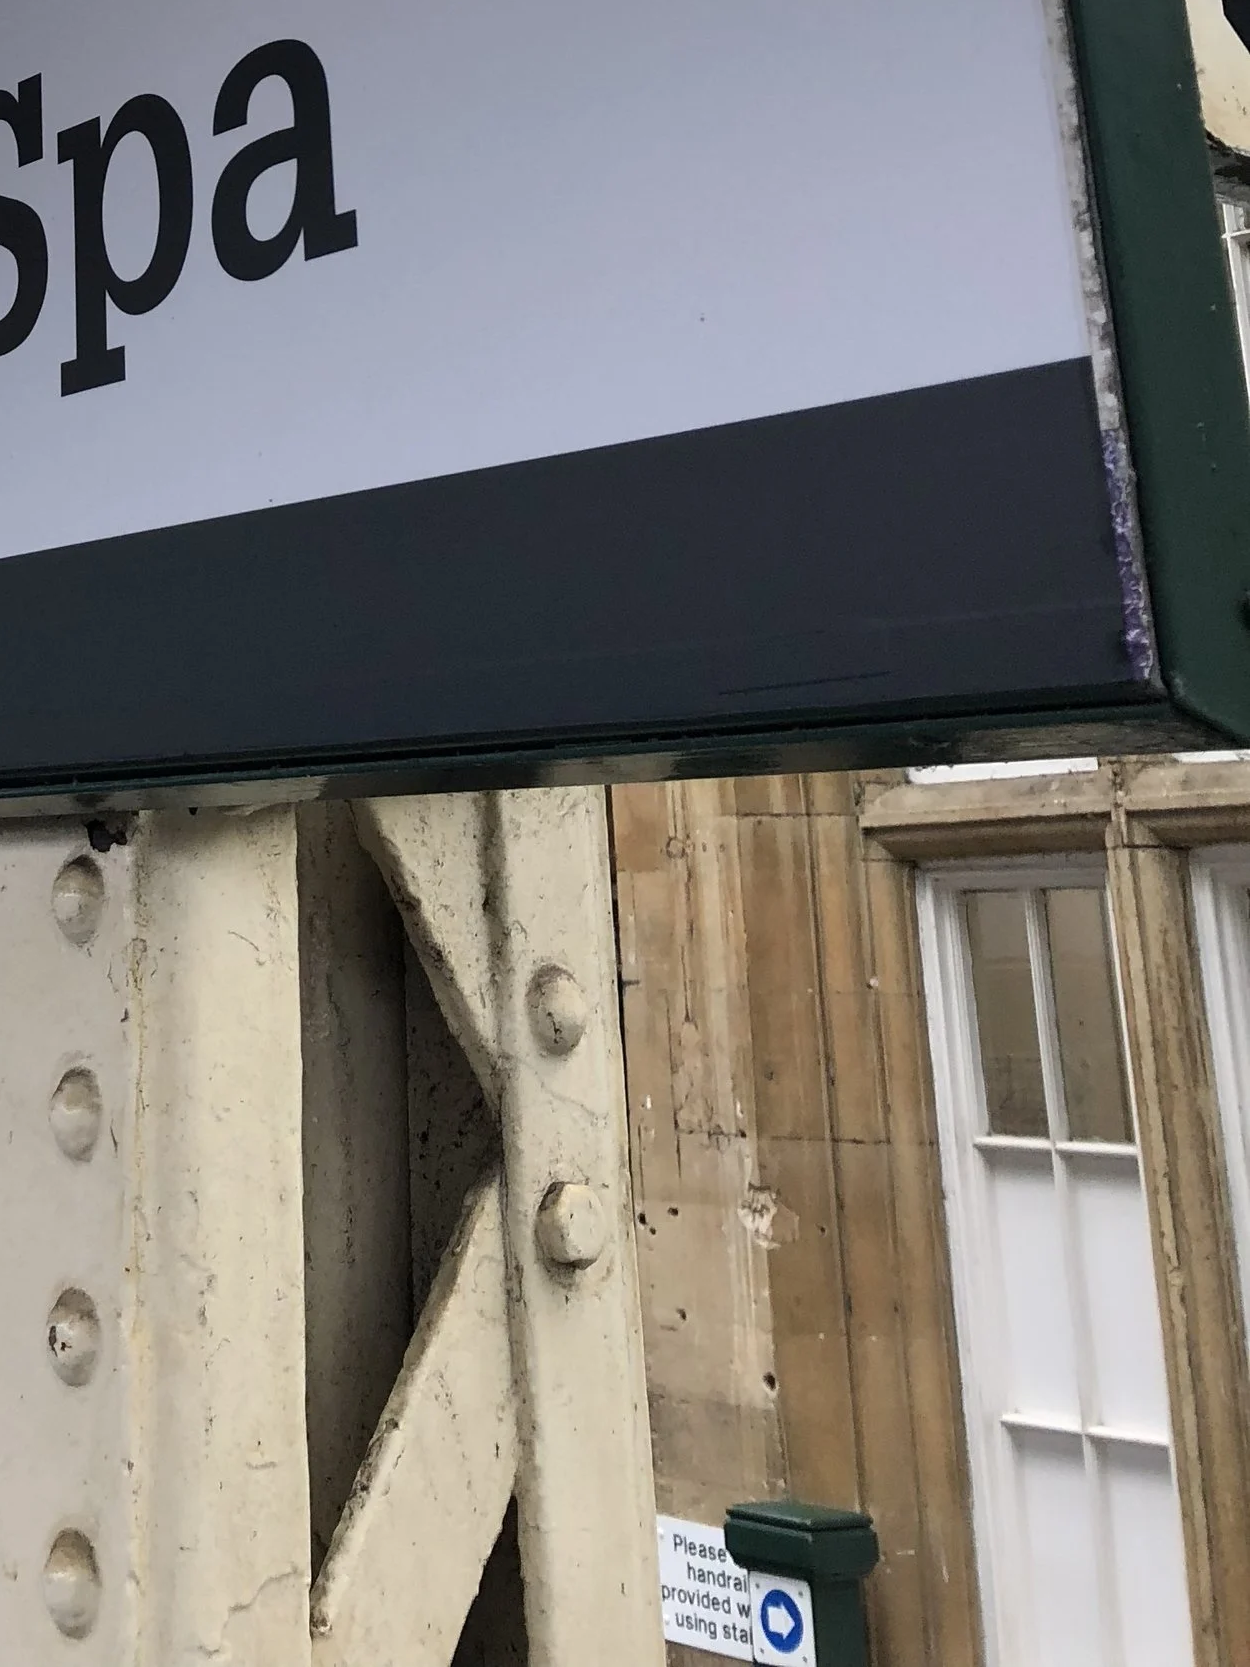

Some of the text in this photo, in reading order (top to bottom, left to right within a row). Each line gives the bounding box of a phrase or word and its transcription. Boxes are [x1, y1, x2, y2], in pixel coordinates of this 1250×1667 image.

[672, 1533, 728, 1563] Please
[686, 1561, 747, 1594] handrai
[661, 1584, 732, 1615] provided
[674, 1611, 717, 1640] using
